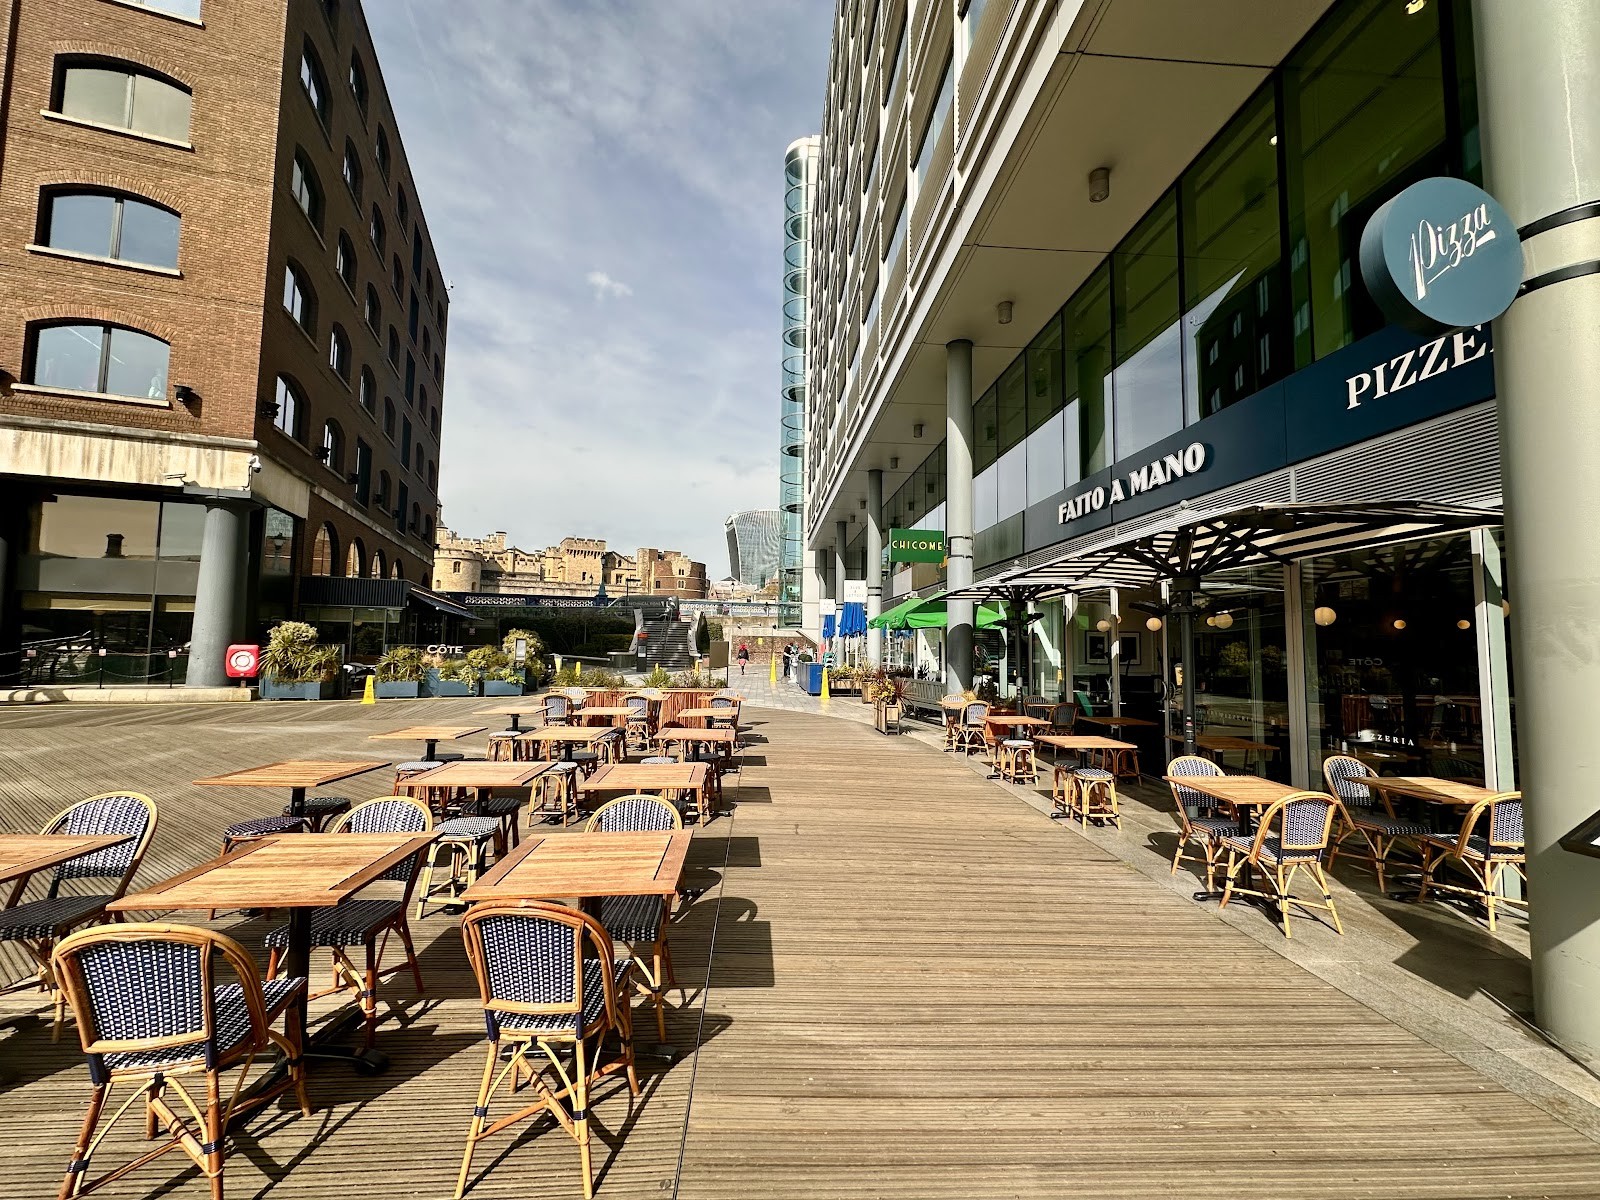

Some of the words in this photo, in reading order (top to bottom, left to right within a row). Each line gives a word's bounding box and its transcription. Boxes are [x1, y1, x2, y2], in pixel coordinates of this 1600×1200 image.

[1409, 203, 1492, 301] Pizza
[1346, 325, 1494, 410] PIZZE
[1058, 486, 1105, 524] FATTO
[1109, 478, 1125, 505] A
[1128, 442, 1206, 496] MANO
[892, 540, 942, 551] CHICOME
[427, 644, 463, 654] CÔTE
[1357, 731, 1414, 746] PZZERIA
